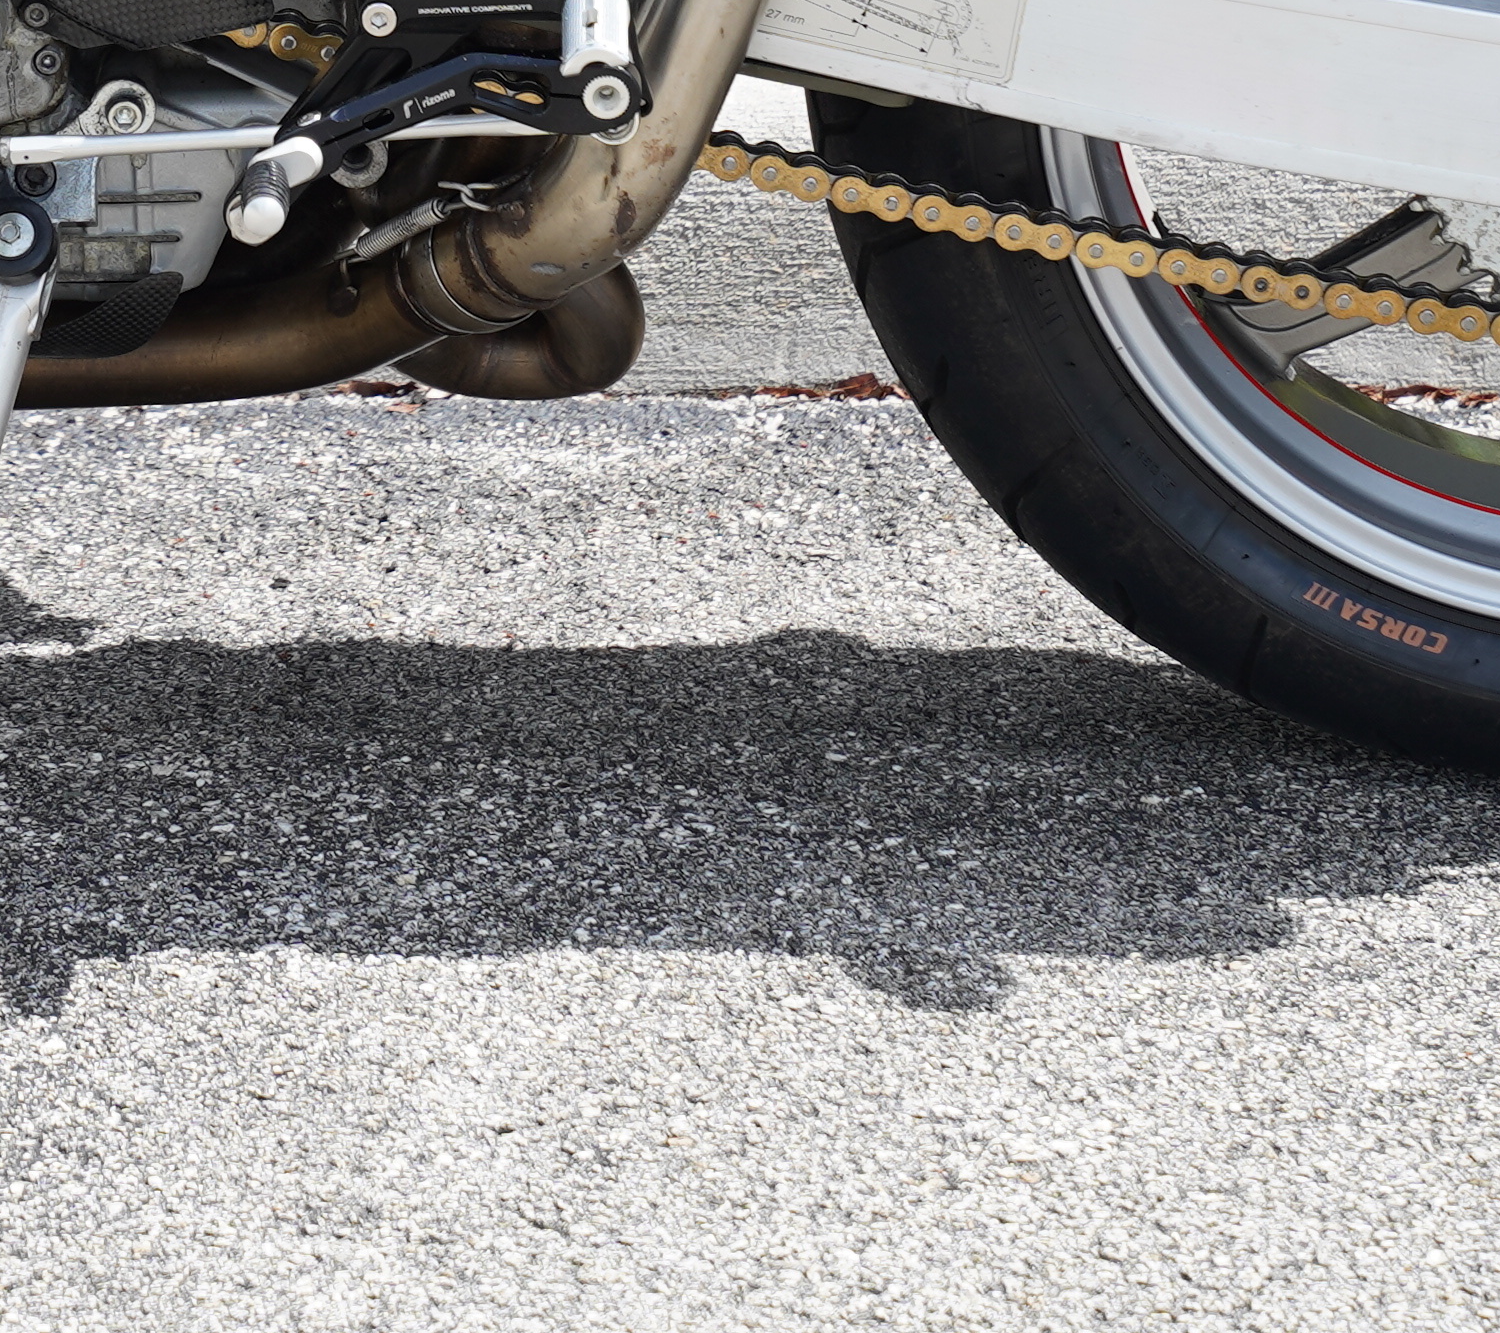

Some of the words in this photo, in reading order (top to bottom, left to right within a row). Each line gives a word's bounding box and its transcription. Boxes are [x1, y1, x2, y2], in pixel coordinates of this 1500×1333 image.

[418, 6, 471, 15] INNOVATIVE
[471, 4, 533, 13] COMPONENTS
[783, 13, 805, 26] mm
[421, 88, 456, 108] rizoma
[1302, 581, 1340, 611] III
[1340, 598, 1448, 654] CORSA
